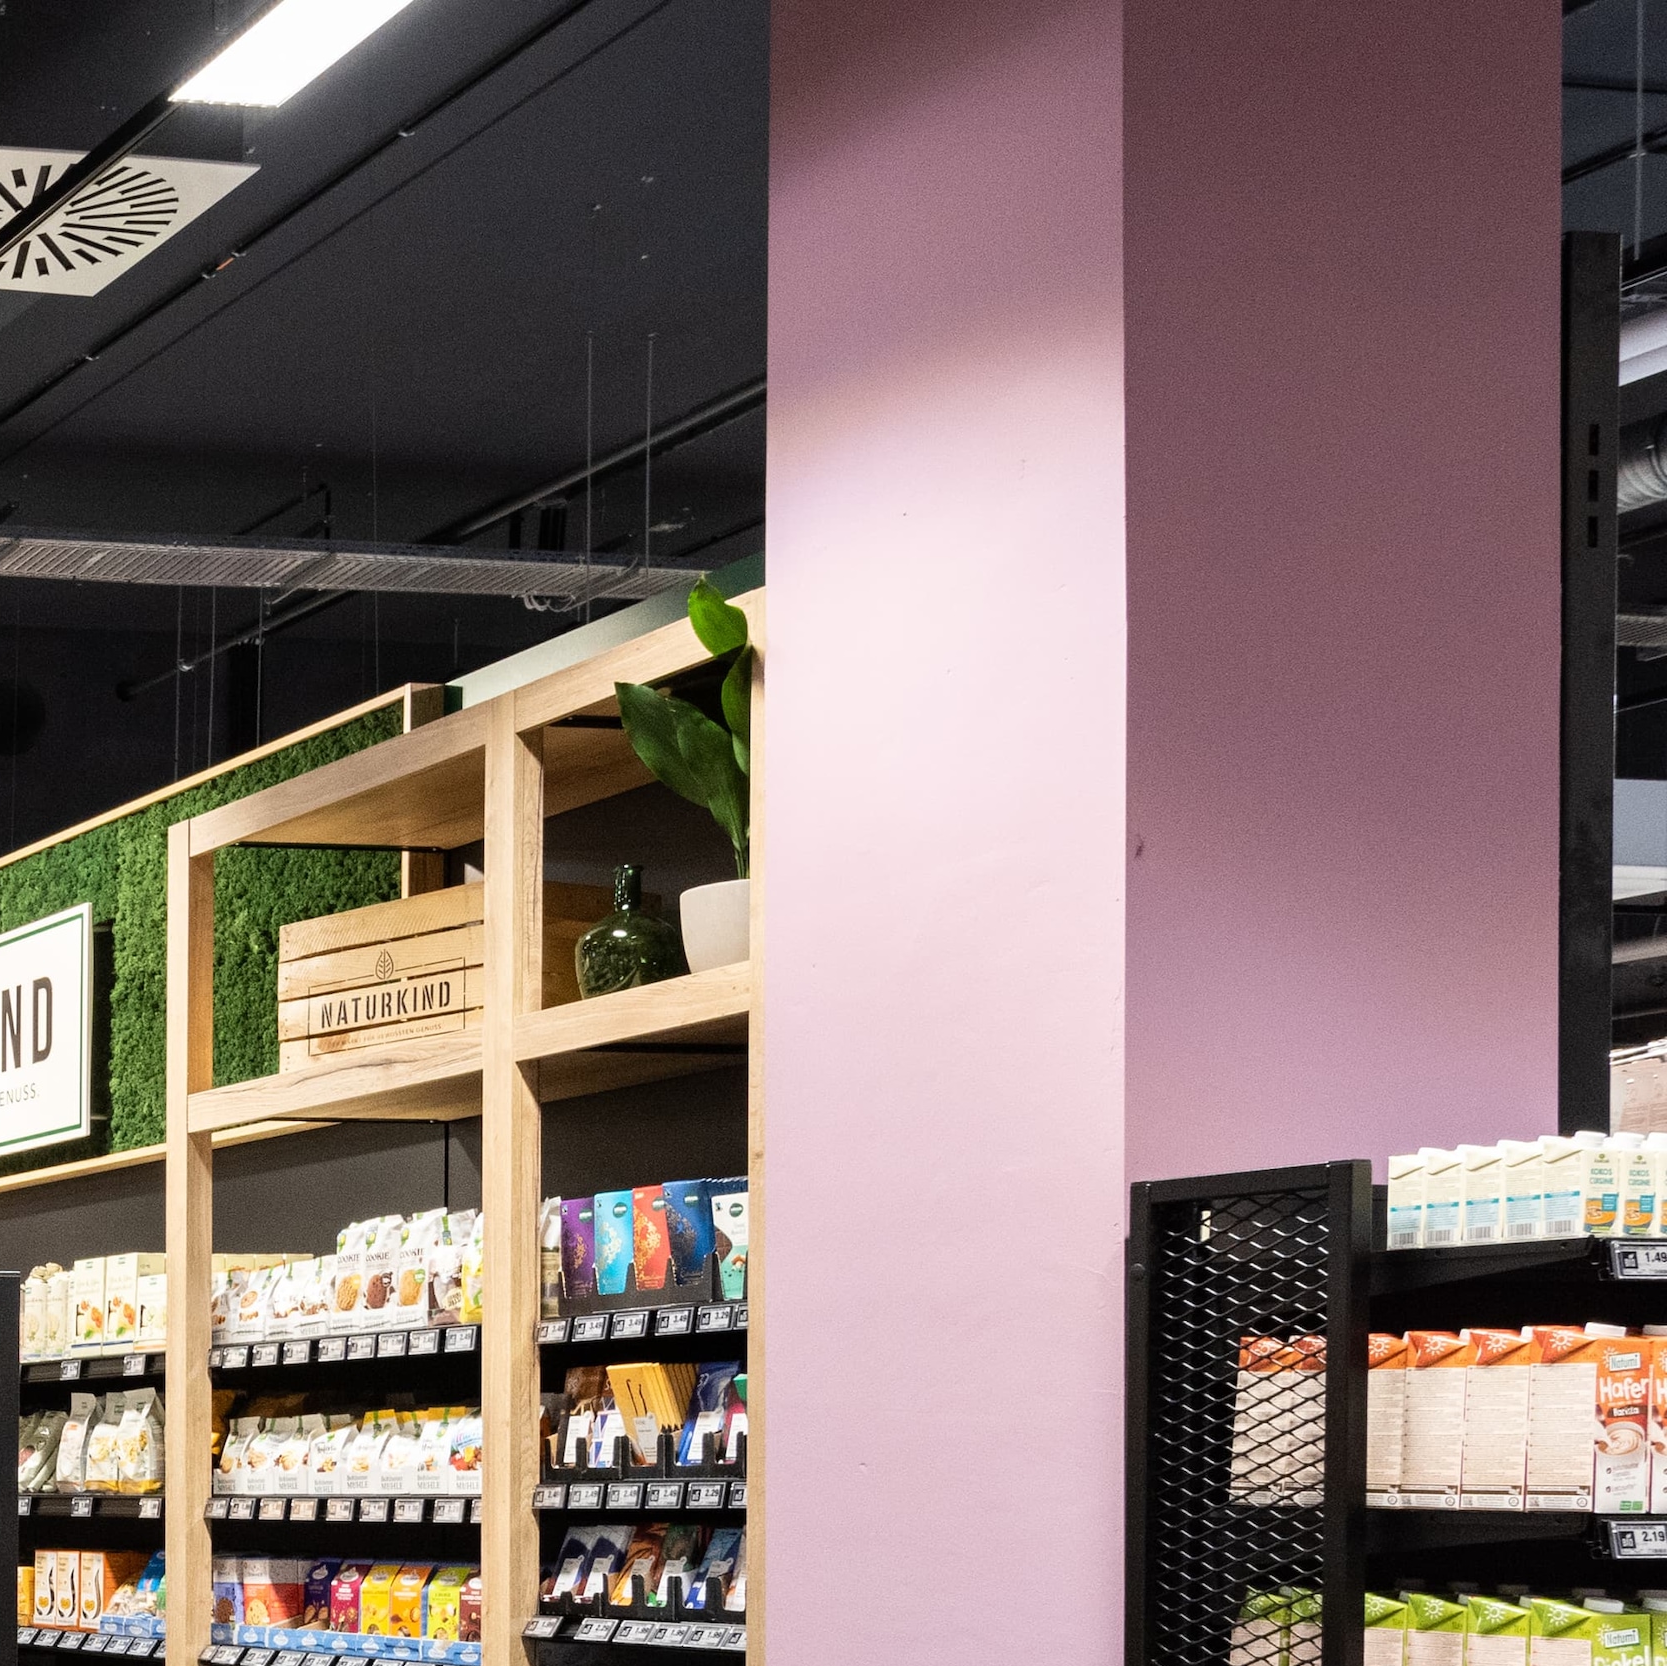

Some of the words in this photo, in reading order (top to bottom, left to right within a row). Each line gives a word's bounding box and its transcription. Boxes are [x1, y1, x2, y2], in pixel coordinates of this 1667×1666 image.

[321, 981, 451, 1030] NATURKIND
[1599, 1376, 1649, 1402] Hafer
[1641, 1530, 1665, 1543] 2.19
